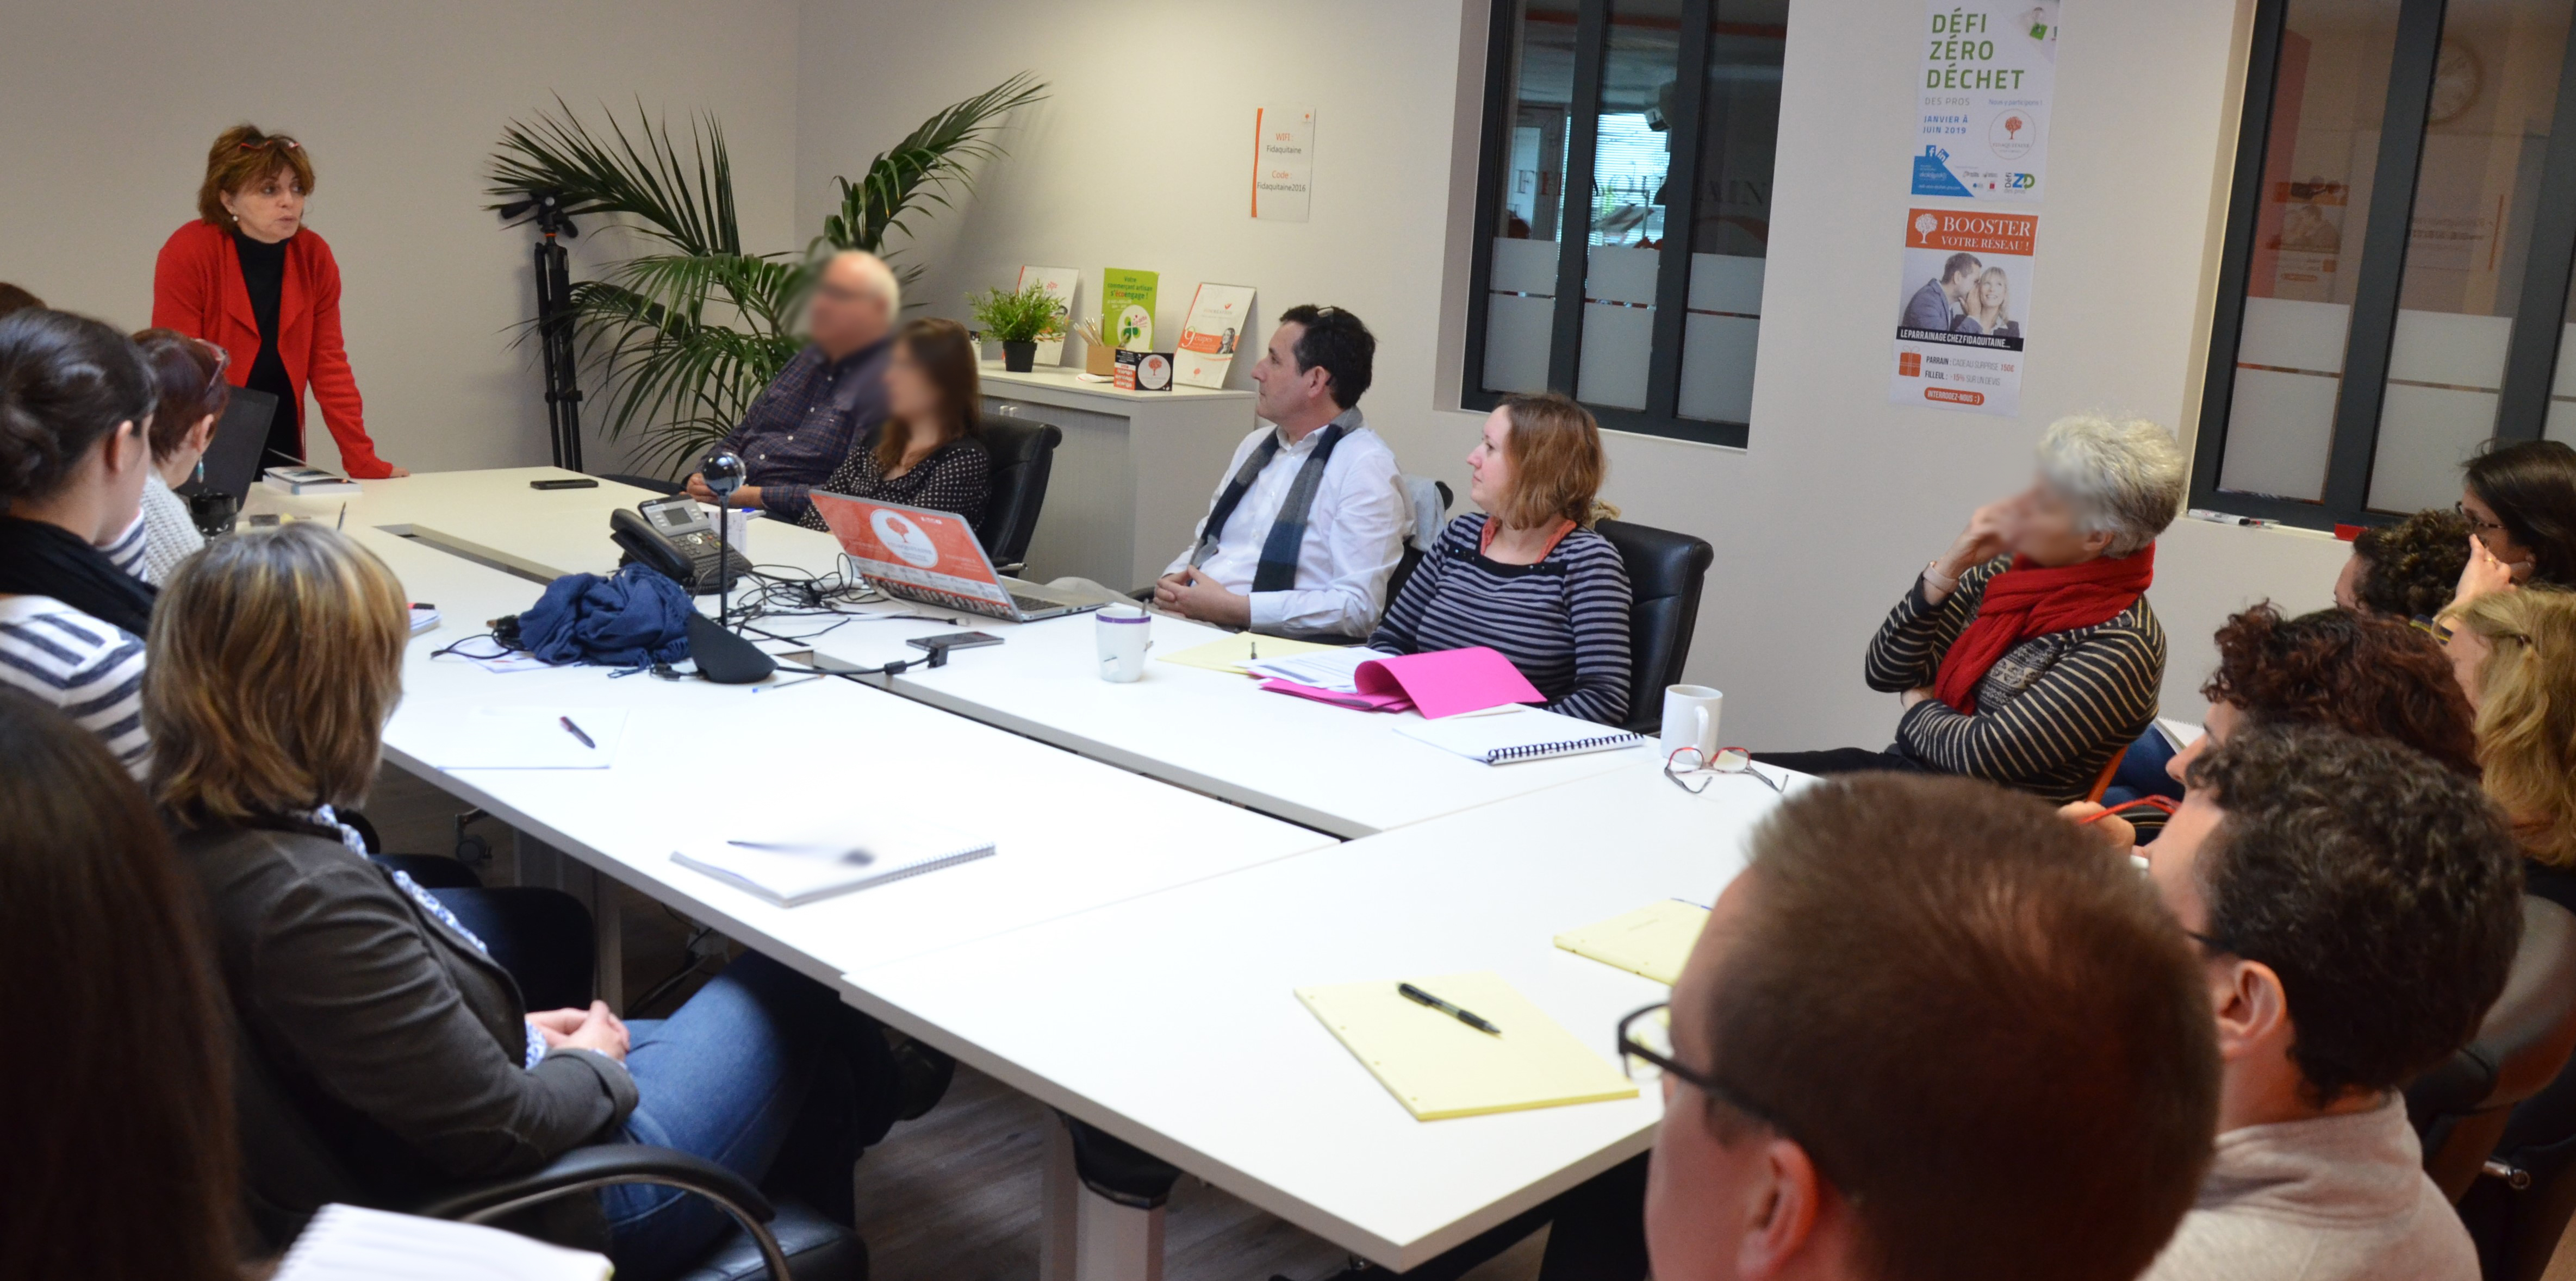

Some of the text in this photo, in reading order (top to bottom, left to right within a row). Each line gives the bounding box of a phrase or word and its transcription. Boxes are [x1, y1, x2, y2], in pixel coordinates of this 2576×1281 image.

[1932, 7, 1987, 34] DÉFI
[1930, 34, 1994, 60] ZÉRO
[1927, 63, 2024, 89] DÉCHET
[1925, 97, 1942, 105] DES
[1276, 133, 1290, 141] WIFI
[1266, 145, 1302, 154] Fidaquitaine
[1272, 170, 1289, 179] Code
[1257, 182, 1306, 192] Fidaquitaine2016
[1943, 216, 2031, 237] BOOSTER
[1941, 235, 1978, 248] VOTRE
[1981, 236, 2023, 251] RÉSEAU
[1901, 329, 1908, 338] LE
[1908, 330, 1947, 342] PARRAINAGE
[1947, 333, 1963, 343] CHEZ
[1926, 356, 1949, 365] PARRAIN
[1952, 359, 1974, 368] CADEAU
[1975, 361, 1999, 371] SURPRISE
[1925, 371, 1944, 379] FILLEUL
[1966, 374, 1977, 383] SUR
[1985, 377, 2000, 386] DEVIS
